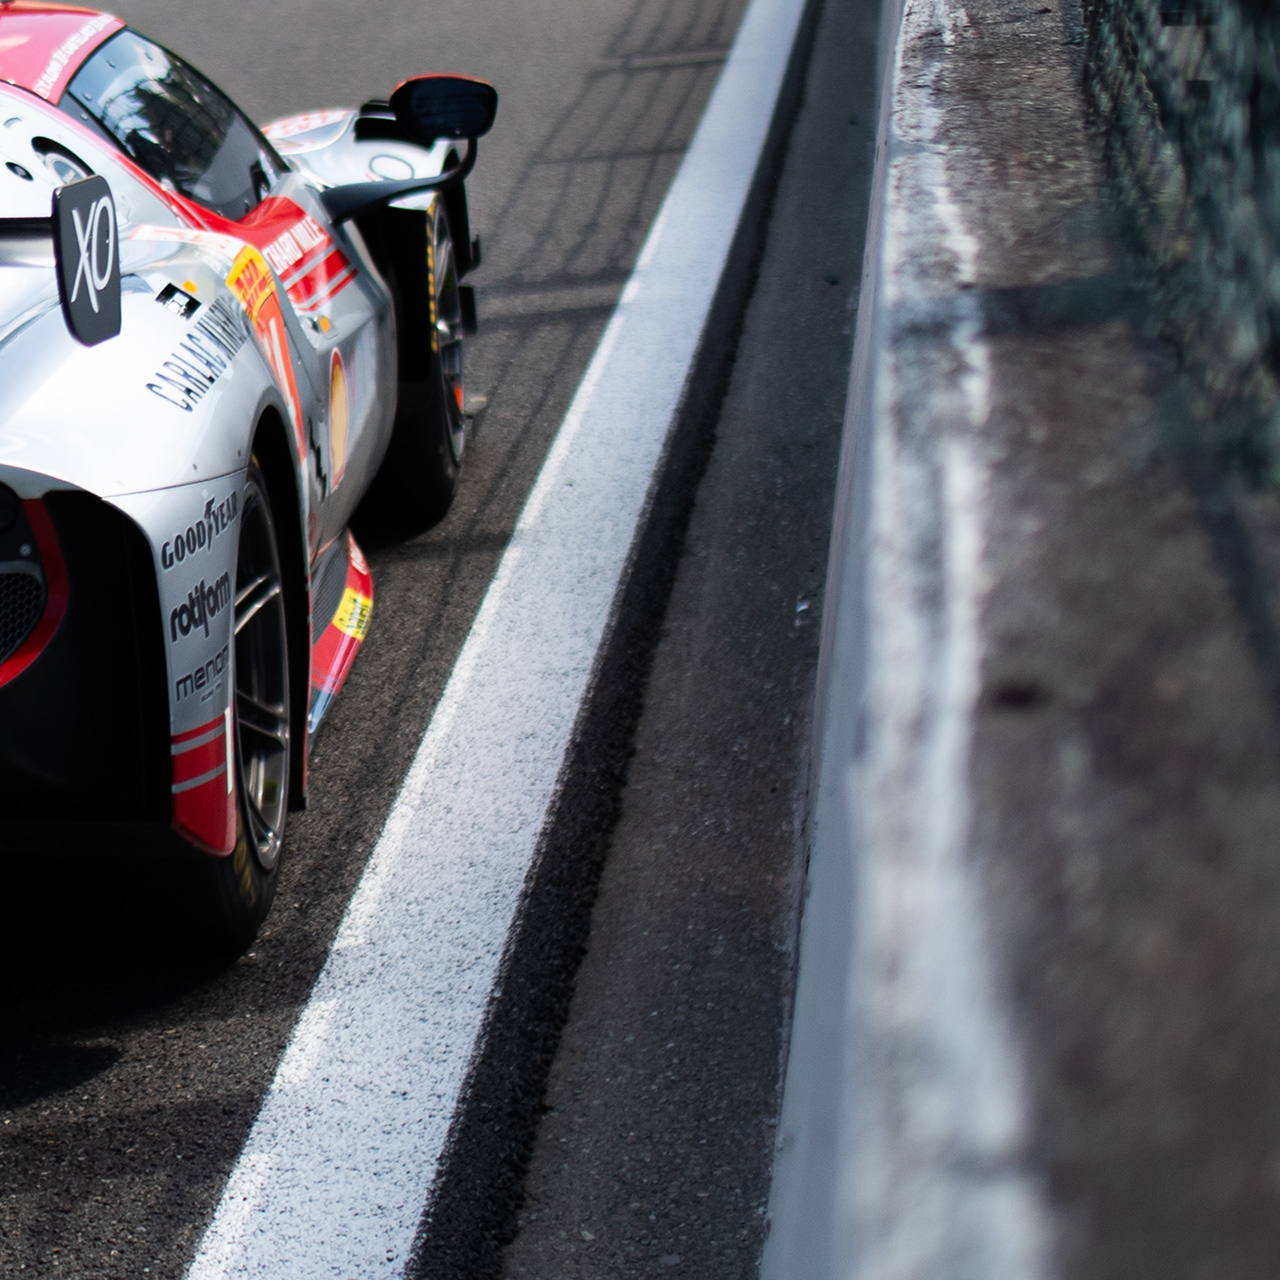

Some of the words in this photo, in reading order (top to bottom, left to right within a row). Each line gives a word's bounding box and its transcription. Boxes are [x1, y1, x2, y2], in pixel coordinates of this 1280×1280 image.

[69, 195, 116, 314] XO
[234, 257, 268, 309] DHL
[160, 489, 239, 572] GOODYEAR
[169, 570, 231, 644] rotiform
